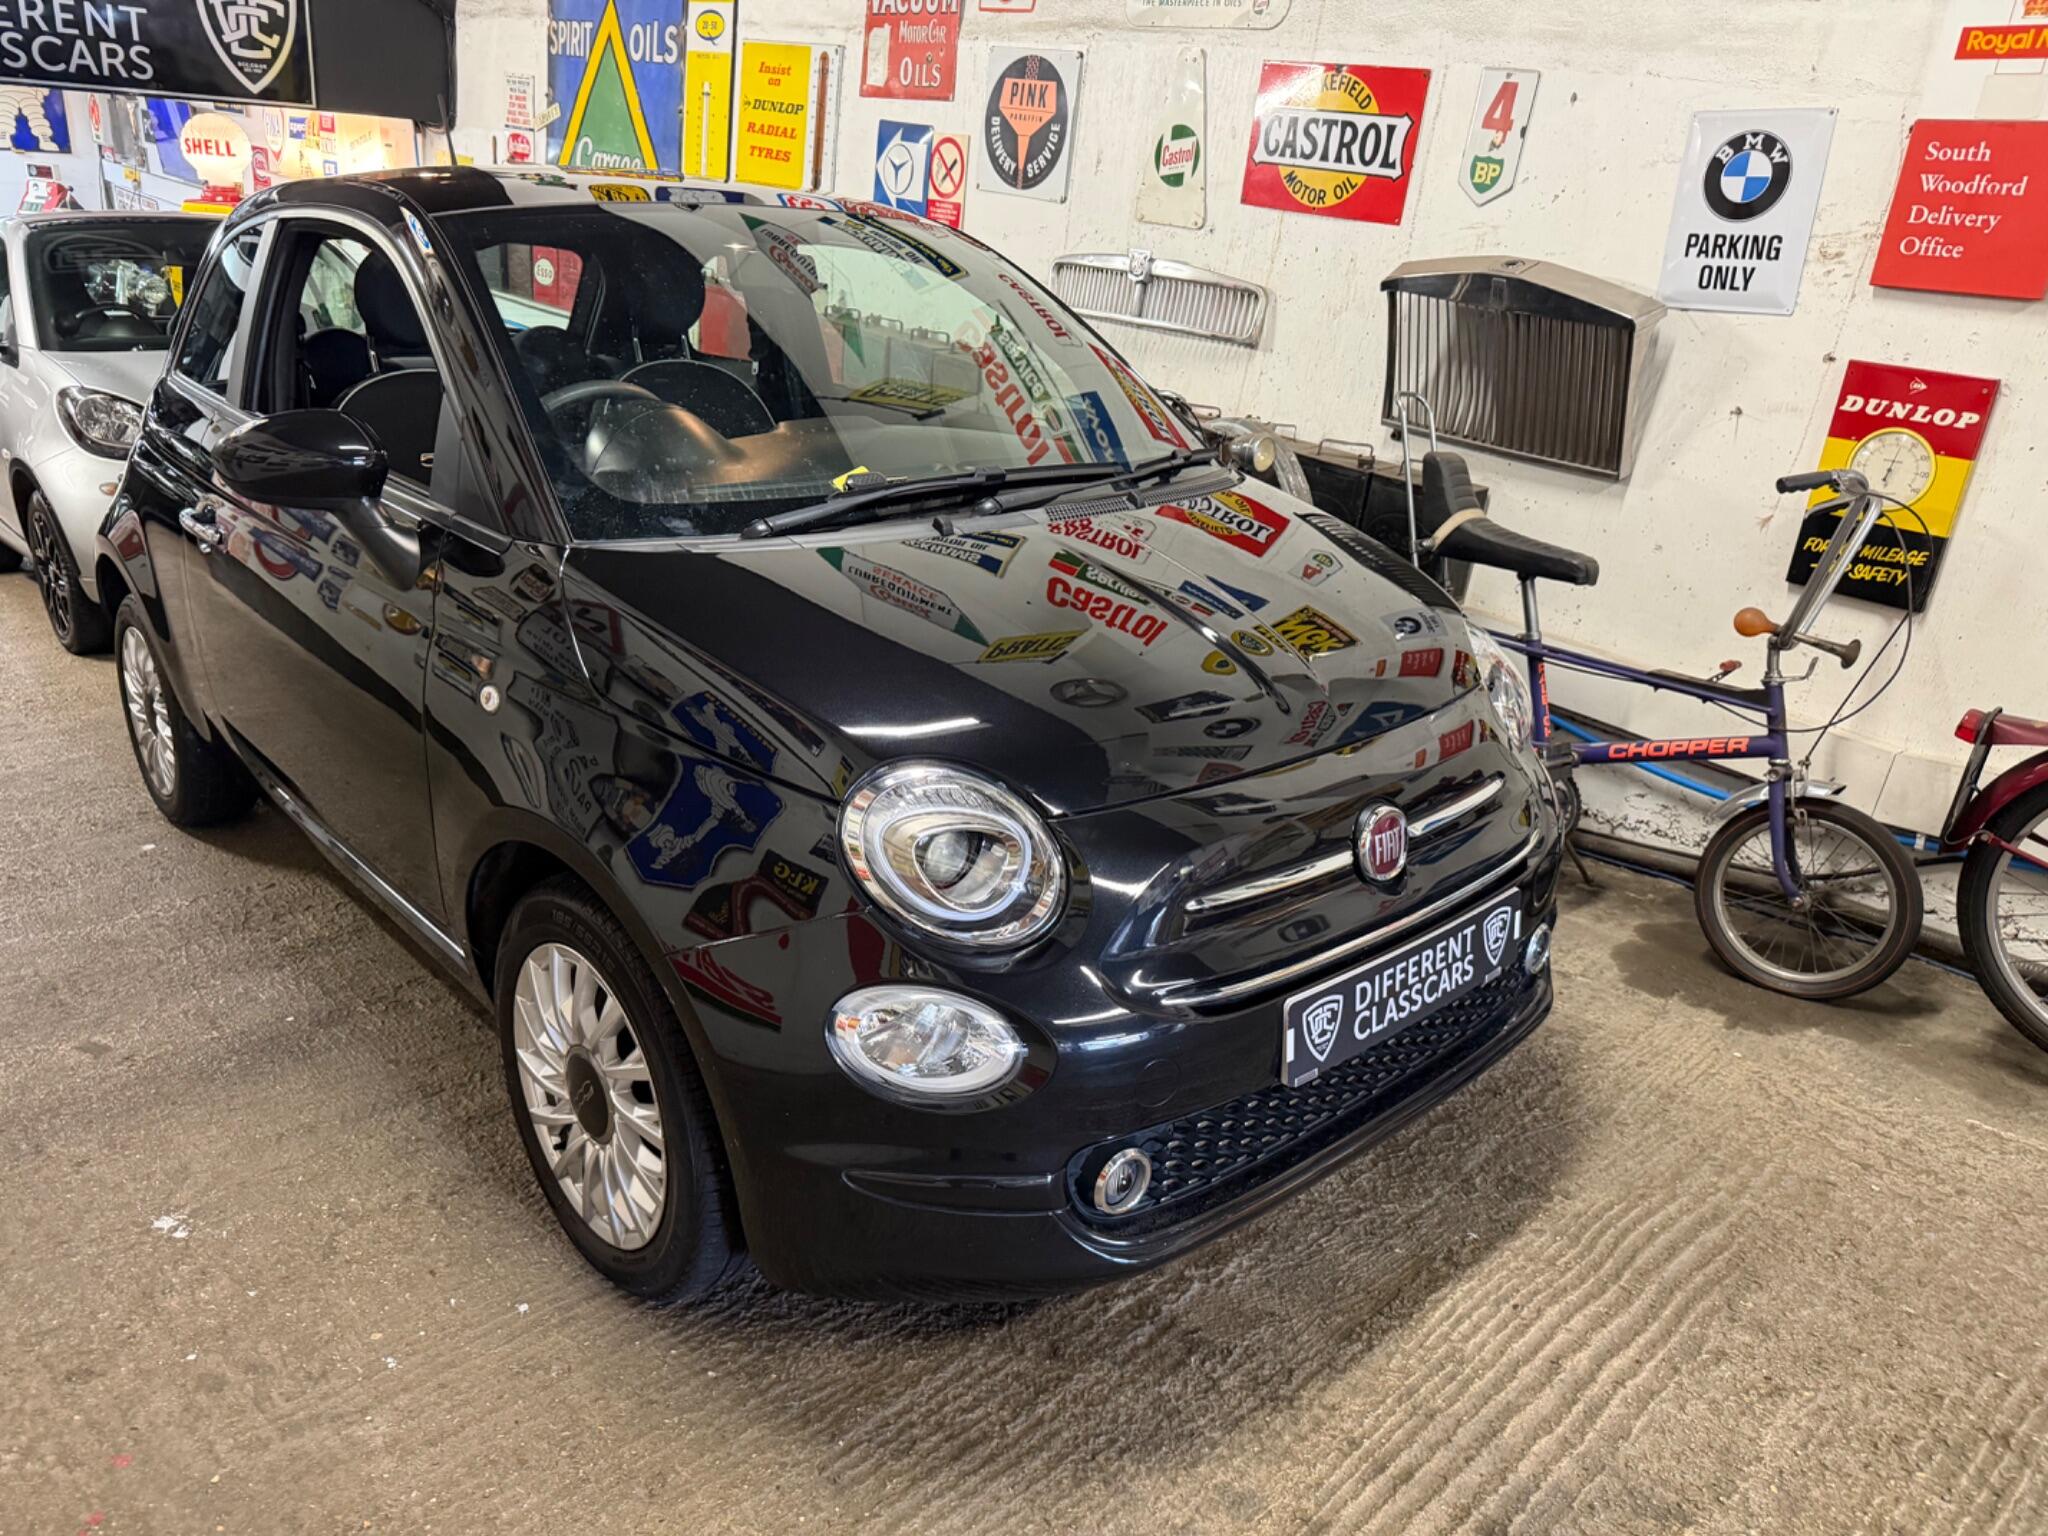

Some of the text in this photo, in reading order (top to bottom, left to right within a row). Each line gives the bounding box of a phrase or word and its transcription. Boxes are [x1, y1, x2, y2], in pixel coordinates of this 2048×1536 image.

[550, 20, 679, 64] SPIRIT OILS
[1966, 28, 2036, 55] Royal
[758, 61, 792, 77] Insist
[768, 78, 781, 87] on
[900, 56, 942, 88] OILS
[752, 98, 804, 116] DUNLOP
[1009, 81, 1049, 109] PINK
[747, 122, 798, 140] RADIAL
[1263, 114, 1399, 171] CASTROL
[184, 137, 237, 157] SHELL
[749, 145, 792, 162] TYRES
[991, 116, 1061, 178] DELIVERY SERVICE
[1162, 141, 1196, 167] Castrol
[1716, 133, 1789, 165] BMW
[1924, 141, 1992, 163] South
[1473, 161, 1500, 185] BP
[1920, 173, 2028, 197] Woodford
[1284, 170, 1358, 206] MOTOR OIL
[1906, 205, 2002, 232] Delivery
[1684, 232, 1783, 262] PARKING
[1899, 236, 1964, 259] Office
[1697, 265, 1756, 292] ONLY
[1839, 394, 1980, 429] DUNLOP
[1859, 544, 1930, 566] MILEAGE
[1848, 563, 1909, 586] SAFETY
[1608, 737, 1750, 759] CHOPPER
[1374, 826, 1400, 867] FIAT
[1354, 924, 1477, 1013] DIFFERENT
[1353, 954, 1475, 1042] CLASSCARS
